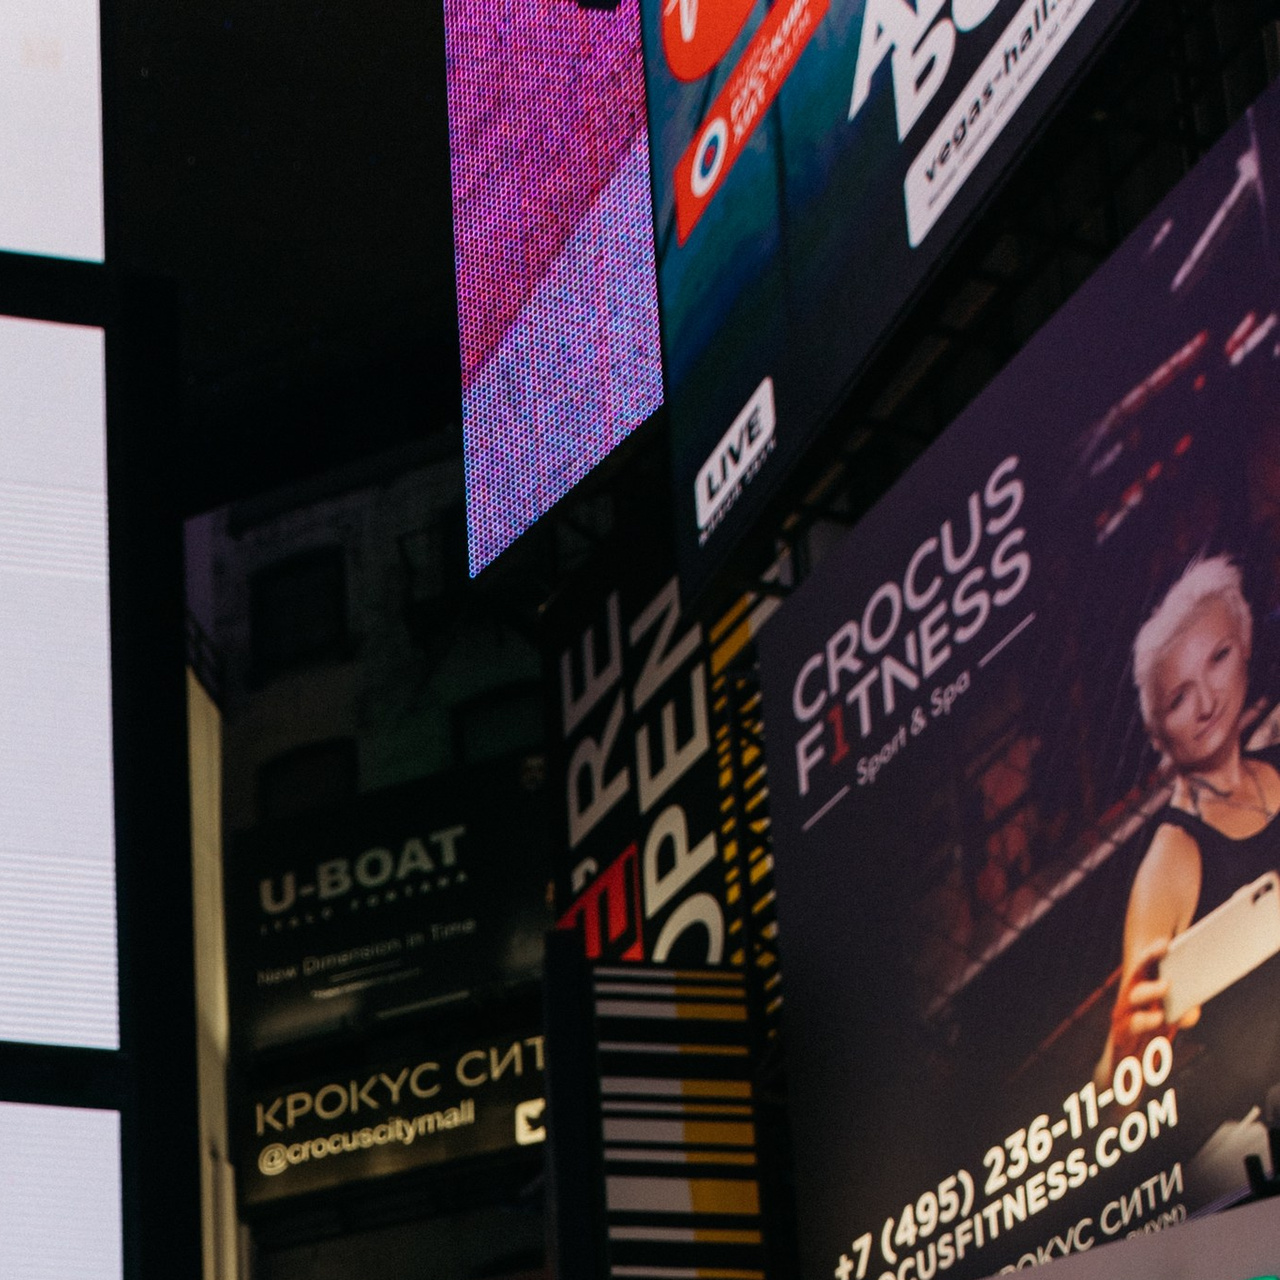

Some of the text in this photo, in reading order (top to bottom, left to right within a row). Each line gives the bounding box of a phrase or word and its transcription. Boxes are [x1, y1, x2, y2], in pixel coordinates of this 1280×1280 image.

[706, 405, 763, 500] LIVE
[793, 455, 1024, 722] CROCUS
[856, 670, 970, 785] Sport & Spa
[259, 825, 466, 914] U-BOAT
[255, 1061, 440, 1136] КРОКУС
[258, 1098, 475, 1176] @crocuscitymall
[881, 1169, 975, 1264] (495)
[983, 1036, 1173, 1196] 236-11-00
[1100, 1162, 1184, 1236] СИТИ
